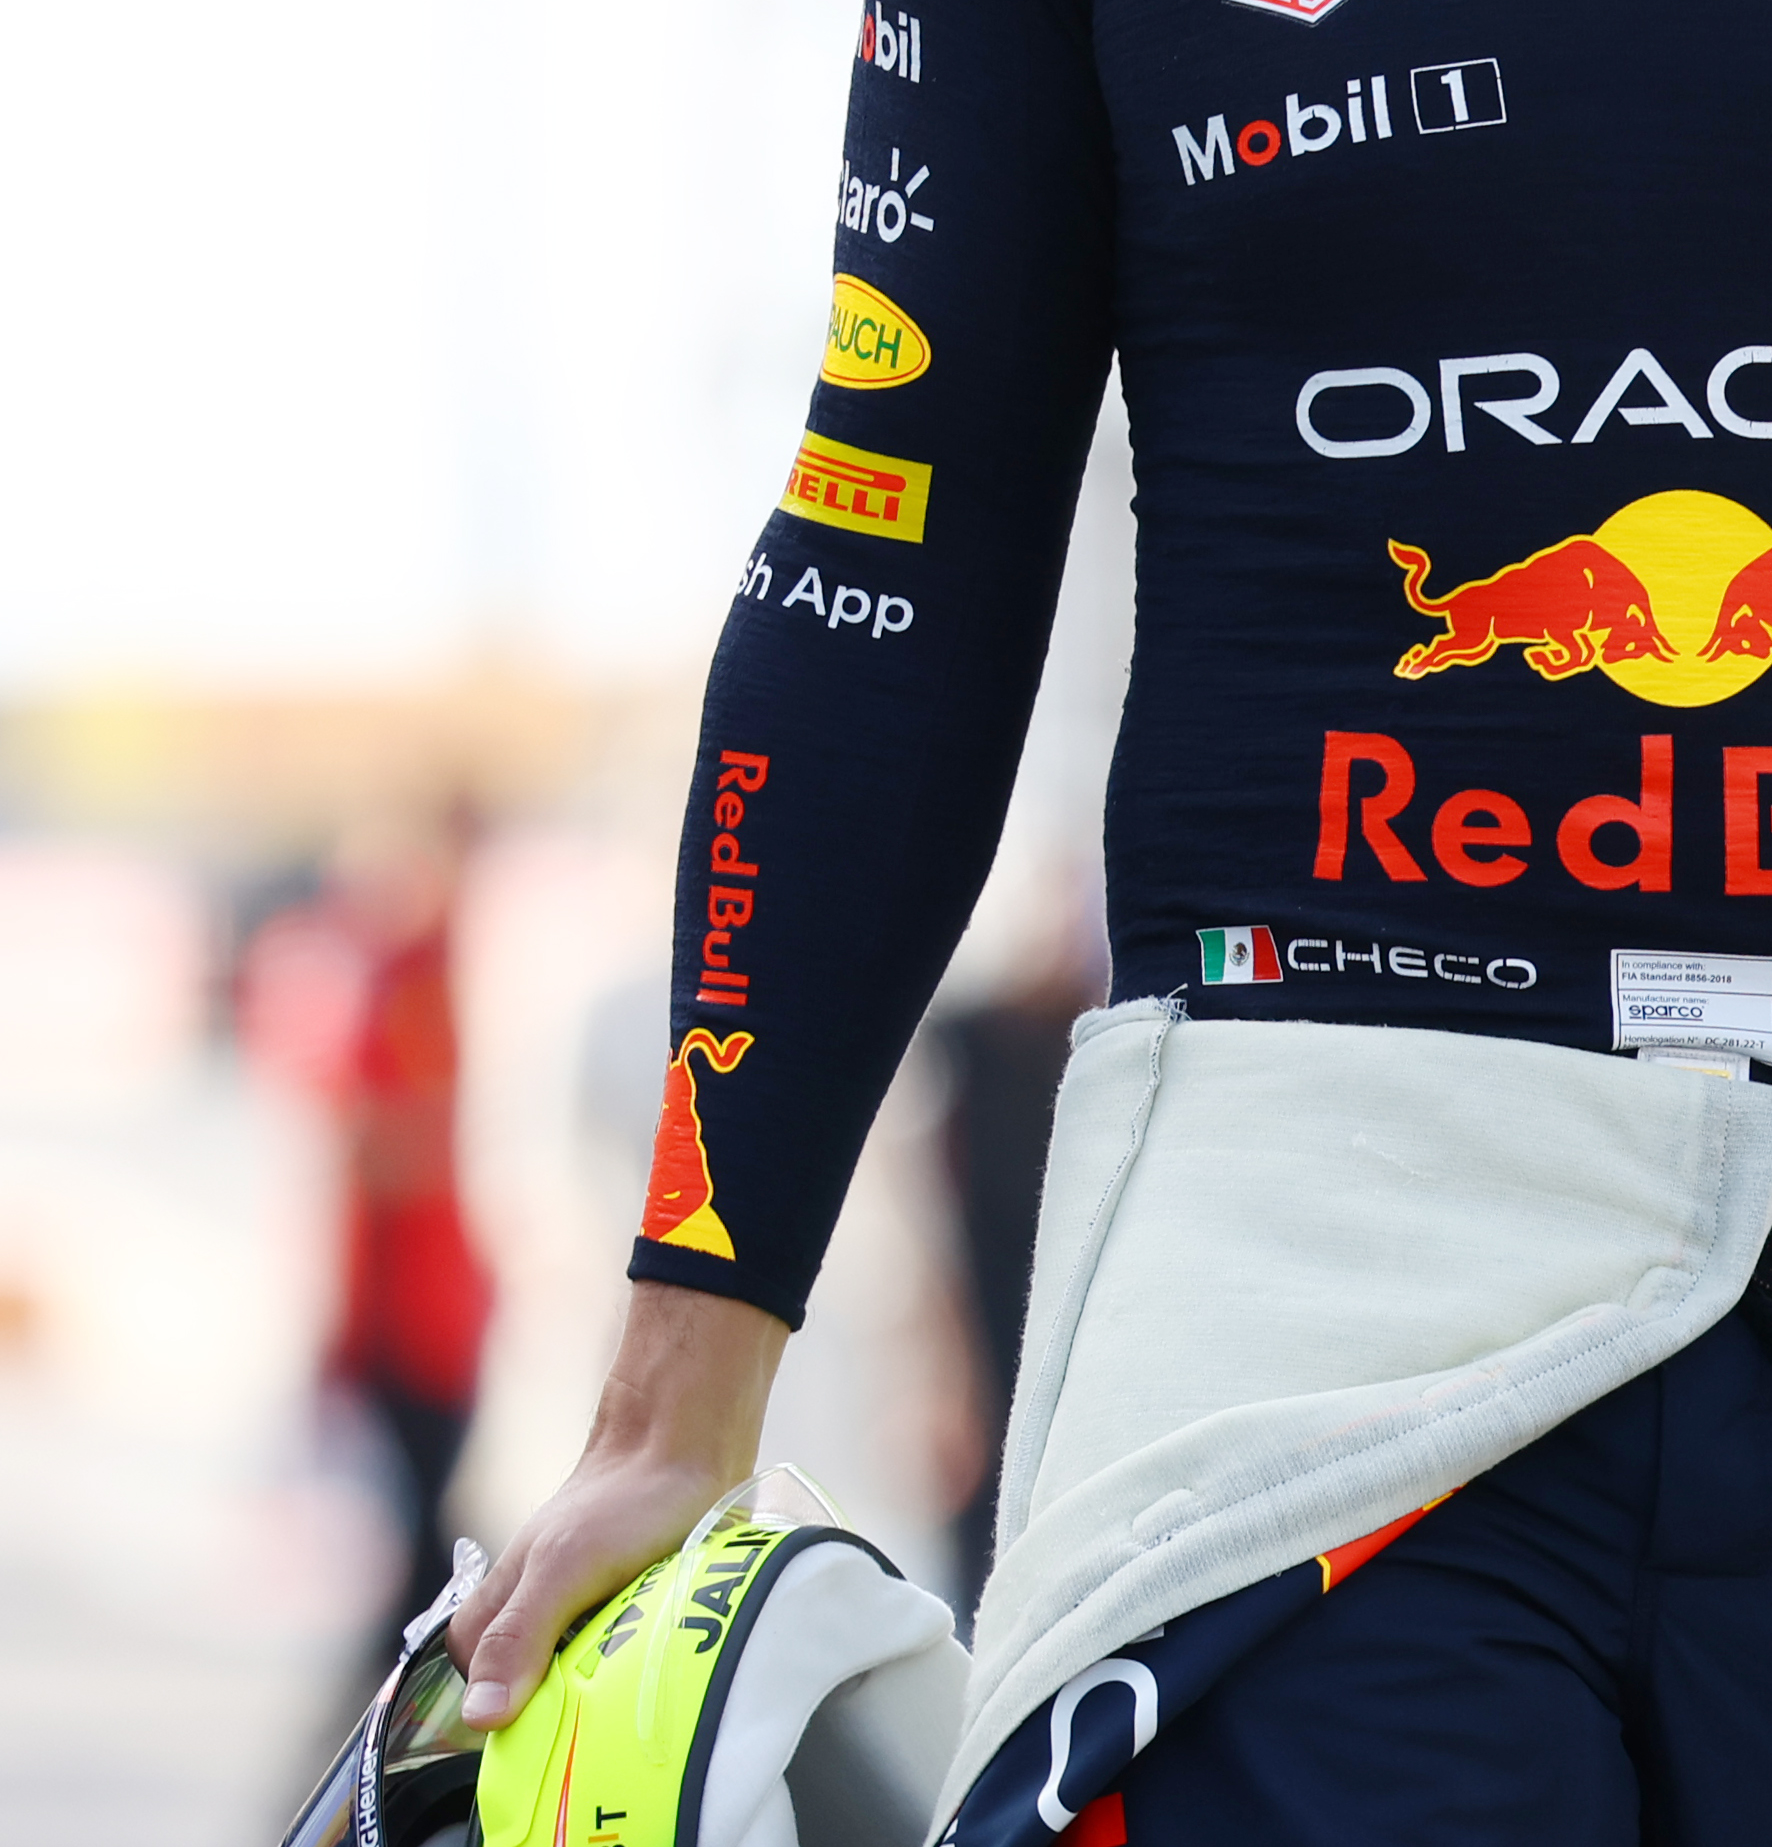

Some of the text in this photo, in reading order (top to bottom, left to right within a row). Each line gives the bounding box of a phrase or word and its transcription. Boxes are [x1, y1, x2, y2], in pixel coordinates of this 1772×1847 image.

[858, 0, 921, 84] obil
[1172, 74, 1396, 186] Mobil
[840, 159, 907, 243] laro
[786, 468, 900, 522] RELLI
[782, 566, 914, 639] App
[1312, 729, 1674, 893] Red
[696, 749, 770, 1007] Red Bull
[1287, 937, 1538, 990] CHECO
[1621, 960, 1630, 969] In
[1632, 962, 1683, 972] compliance
[1621, 973, 1732, 984] FIA Standard 8856-2018
[1623, 994, 1680, 1003] Manufacturer
[1629, 1005, 1704, 1020] sparco
[1625, 1035, 1685, 1045] Homologation
